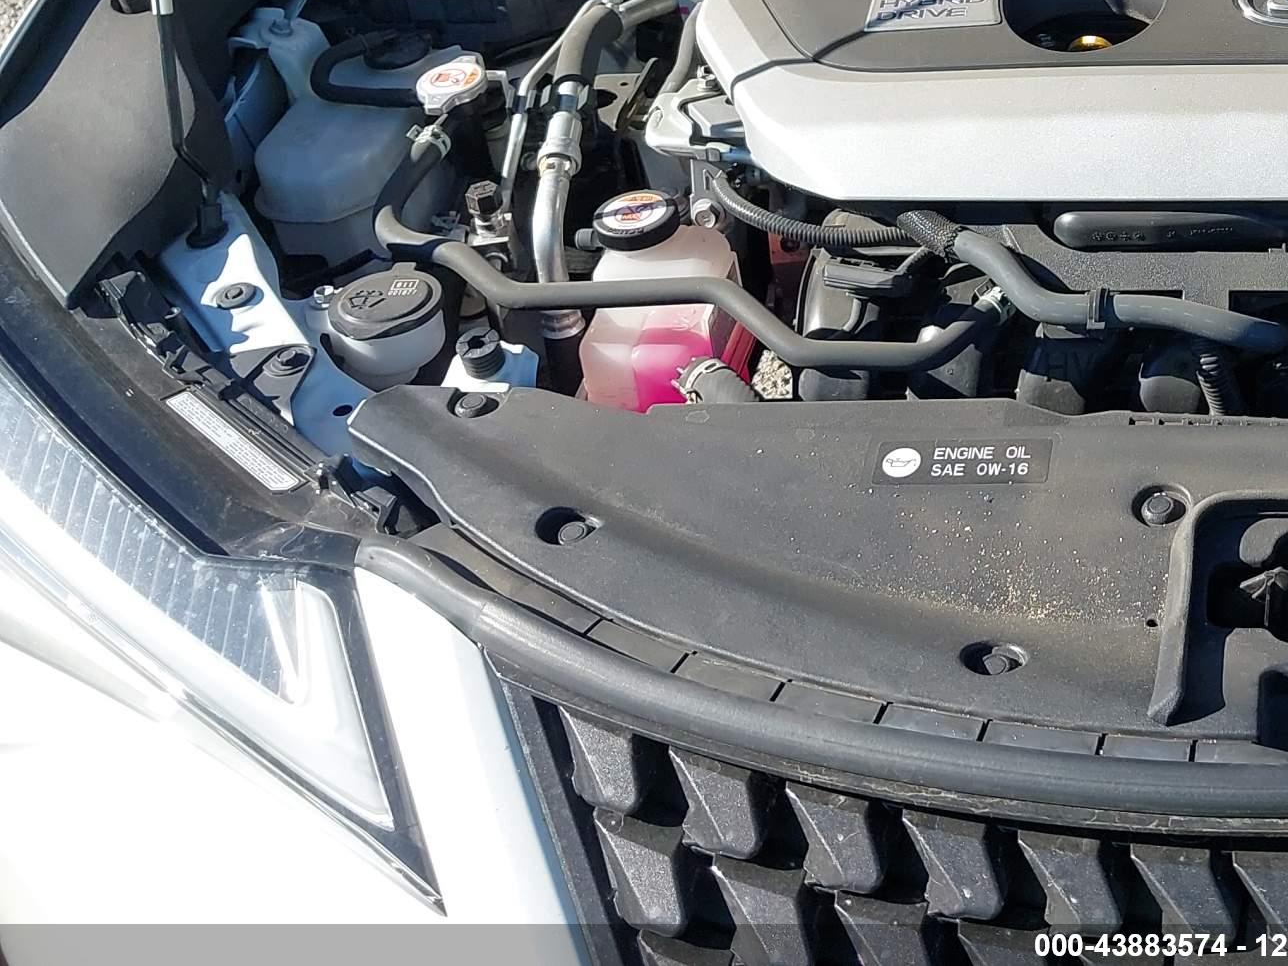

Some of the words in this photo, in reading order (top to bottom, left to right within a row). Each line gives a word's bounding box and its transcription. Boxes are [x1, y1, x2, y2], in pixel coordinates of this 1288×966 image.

[875, 7, 967, 21] DRIVE
[933, 446, 995, 460] ENGINE
[1005, 445, 1031, 459] OIL
[930, 463, 966, 476] SAE
[976, 462, 1029, 476] 0W-16
